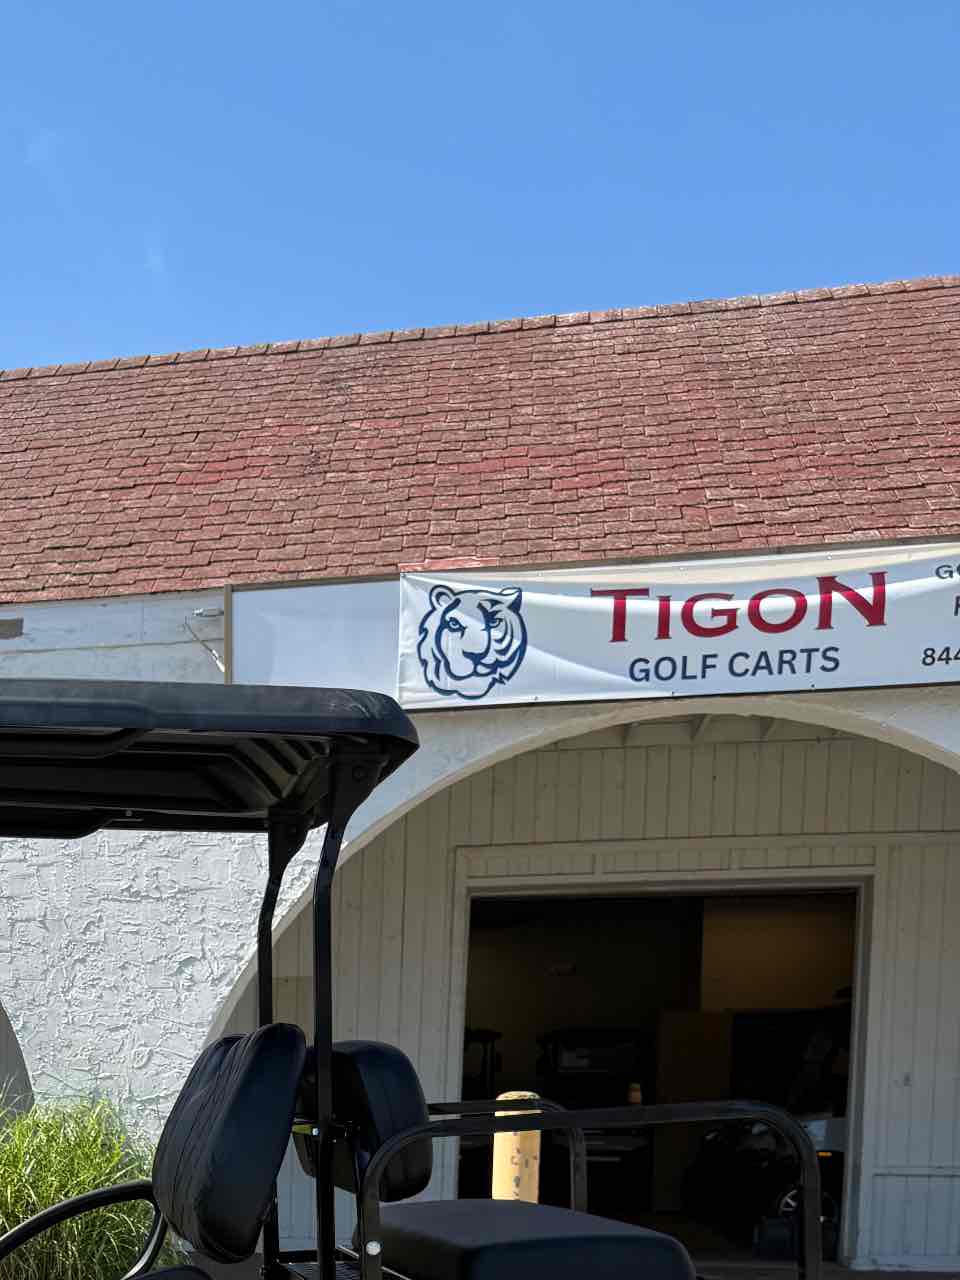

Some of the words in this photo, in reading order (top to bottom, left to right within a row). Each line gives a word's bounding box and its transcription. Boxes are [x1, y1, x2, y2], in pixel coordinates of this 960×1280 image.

[936, 564, 960, 579] G
[590, 571, 888, 642] TIGON
[628, 653, 718, 682] GOLF
[728, 646, 840, 677] CARTS
